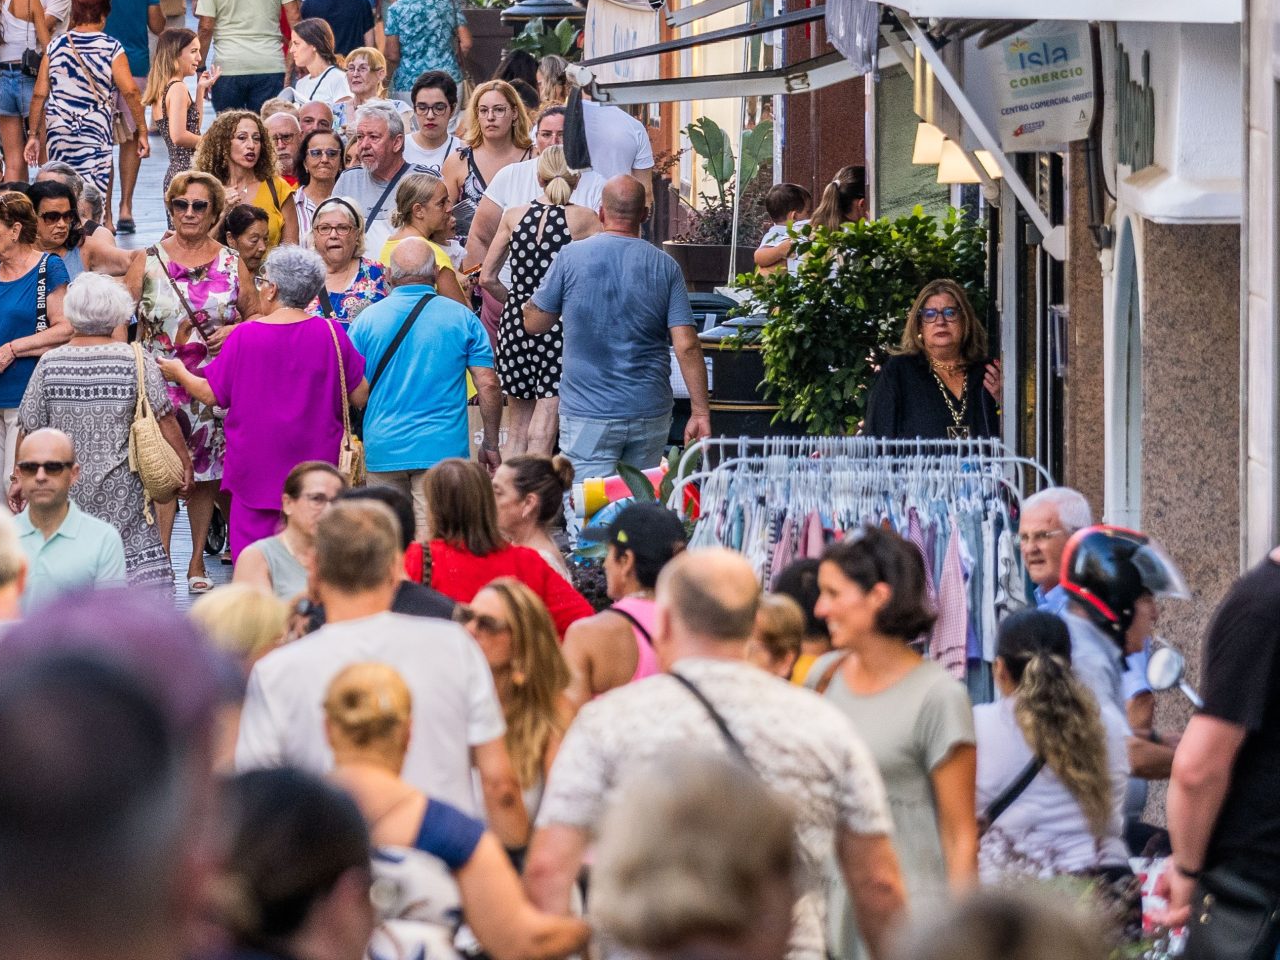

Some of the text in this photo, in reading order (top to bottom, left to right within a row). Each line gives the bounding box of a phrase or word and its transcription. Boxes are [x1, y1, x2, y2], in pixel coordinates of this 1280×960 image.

[1018, 42, 1068, 70] isla
[1009, 67, 1083, 89] COMERCIO
[1001, 104, 1029, 116] CENTRO
[37, 278, 46, 309] BIMBA
